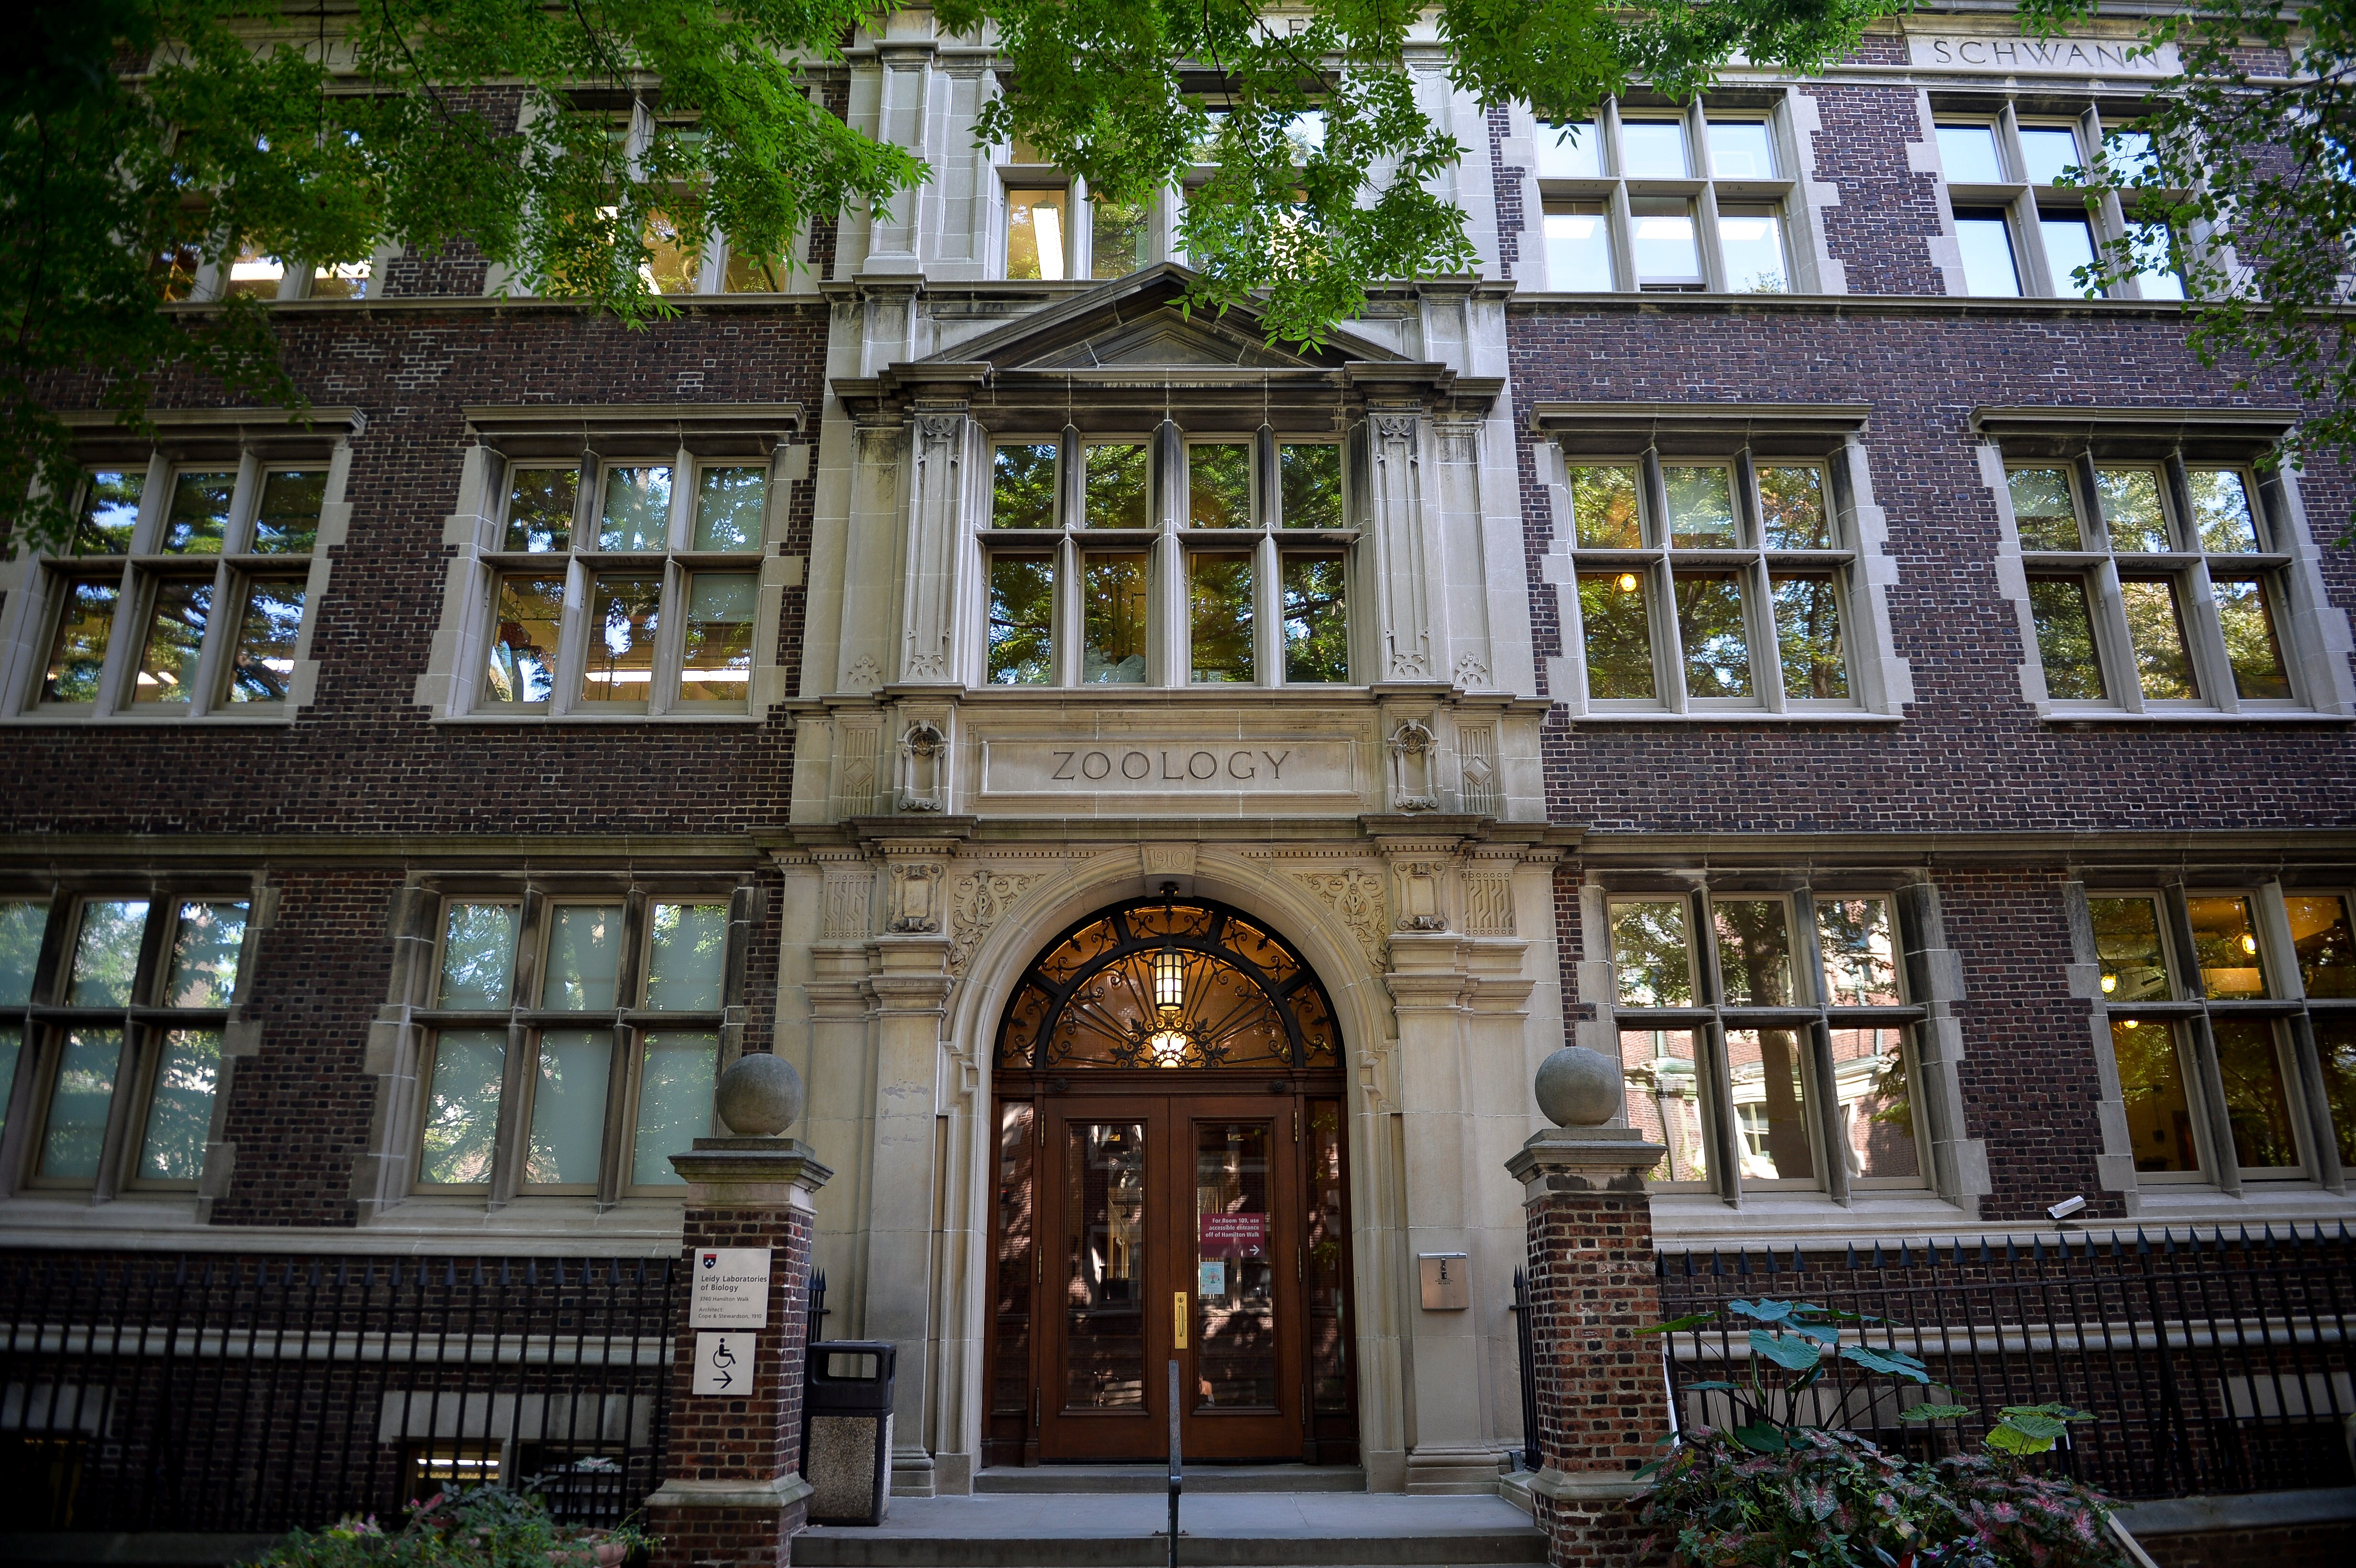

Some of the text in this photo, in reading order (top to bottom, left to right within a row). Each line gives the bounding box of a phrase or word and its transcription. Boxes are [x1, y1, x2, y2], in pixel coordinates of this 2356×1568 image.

[1933, 40, 2160, 69] SCHWANN
[1050, 751, 1291, 781] ZOOLOGY
[1149, 849, 1188, 868] 1910
[701, 1275, 720, 1283] Leidy
[711, 1284, 739, 1292] Biology
